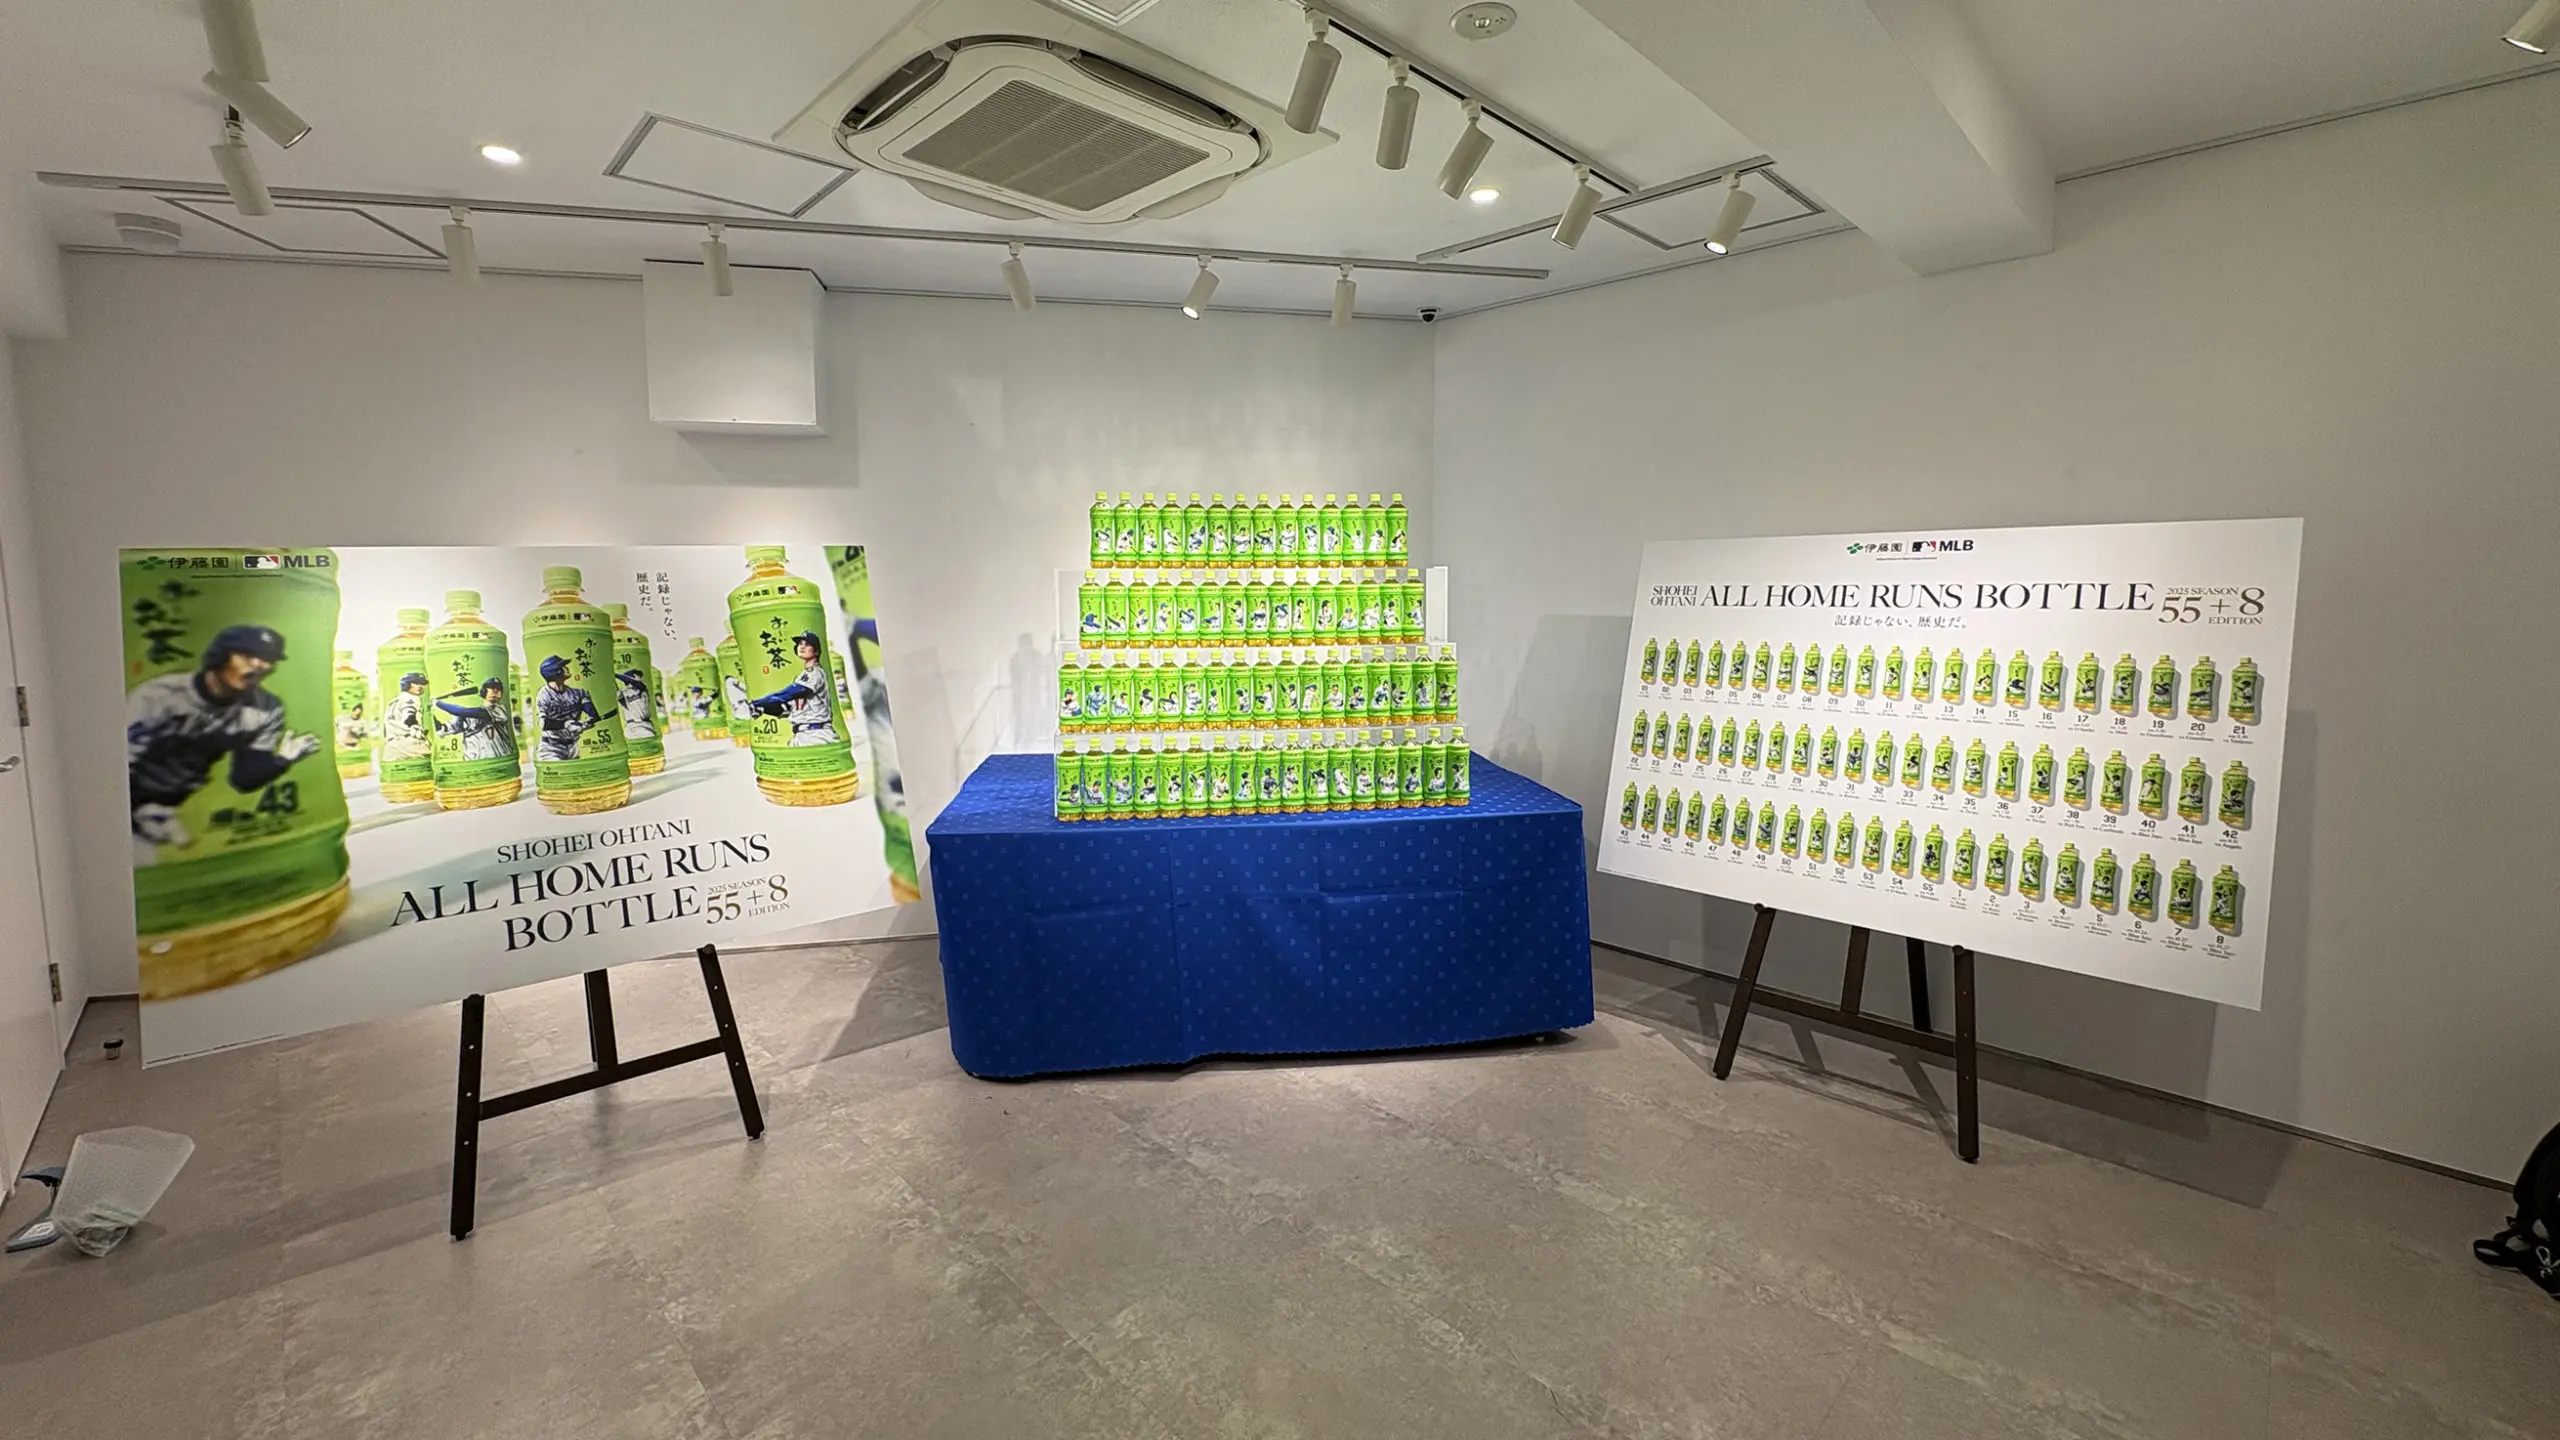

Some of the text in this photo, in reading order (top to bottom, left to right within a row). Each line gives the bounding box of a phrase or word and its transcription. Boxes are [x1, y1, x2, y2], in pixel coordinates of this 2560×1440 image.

[1939, 540, 1974, 552] MLB
[168, 557, 229, 569] 伊藤園
[284, 555, 330, 568] MLB
[1652, 585, 1698, 596] SHOHEI
[2166, 587, 2240, 596] 2025 SEASON
[1700, 582, 2154, 611] ALL HOME RUNS BOTTLE
[1650, 596, 1696, 607] OHTANI
[2208, 616, 2263, 625] EDITION
[2077, 714, 2089, 722] 17
[2115, 717, 2126, 725] 18
[763, 719, 778, 734] 20
[2153, 720, 2164, 728] 19
[2190, 723, 2205, 731] 20
[2233, 725, 2246, 734] 21
[451, 738, 458, 751] 8
[255, 780, 299, 815] 43
[2031, 806, 2043, 814] 37
[2067, 811, 2079, 819] 38
[2103, 815, 2117, 824] 39
[2141, 820, 2156, 828] 40
[2182, 825, 2195, 833] 41
[2222, 830, 2238, 839] 42
[497, 819, 691, 864] SHOHEI OHTANI
[389, 834, 770, 928] ALL HOME RUNS
[727, 877, 767, 890] SEASON
[748, 902, 790, 917] EDITION
[503, 885, 701, 951] BOTTLE
[2097, 914, 2103, 922] 5
[2135, 921, 2142, 929] 6
[2216, 936, 2224, 944] 8
